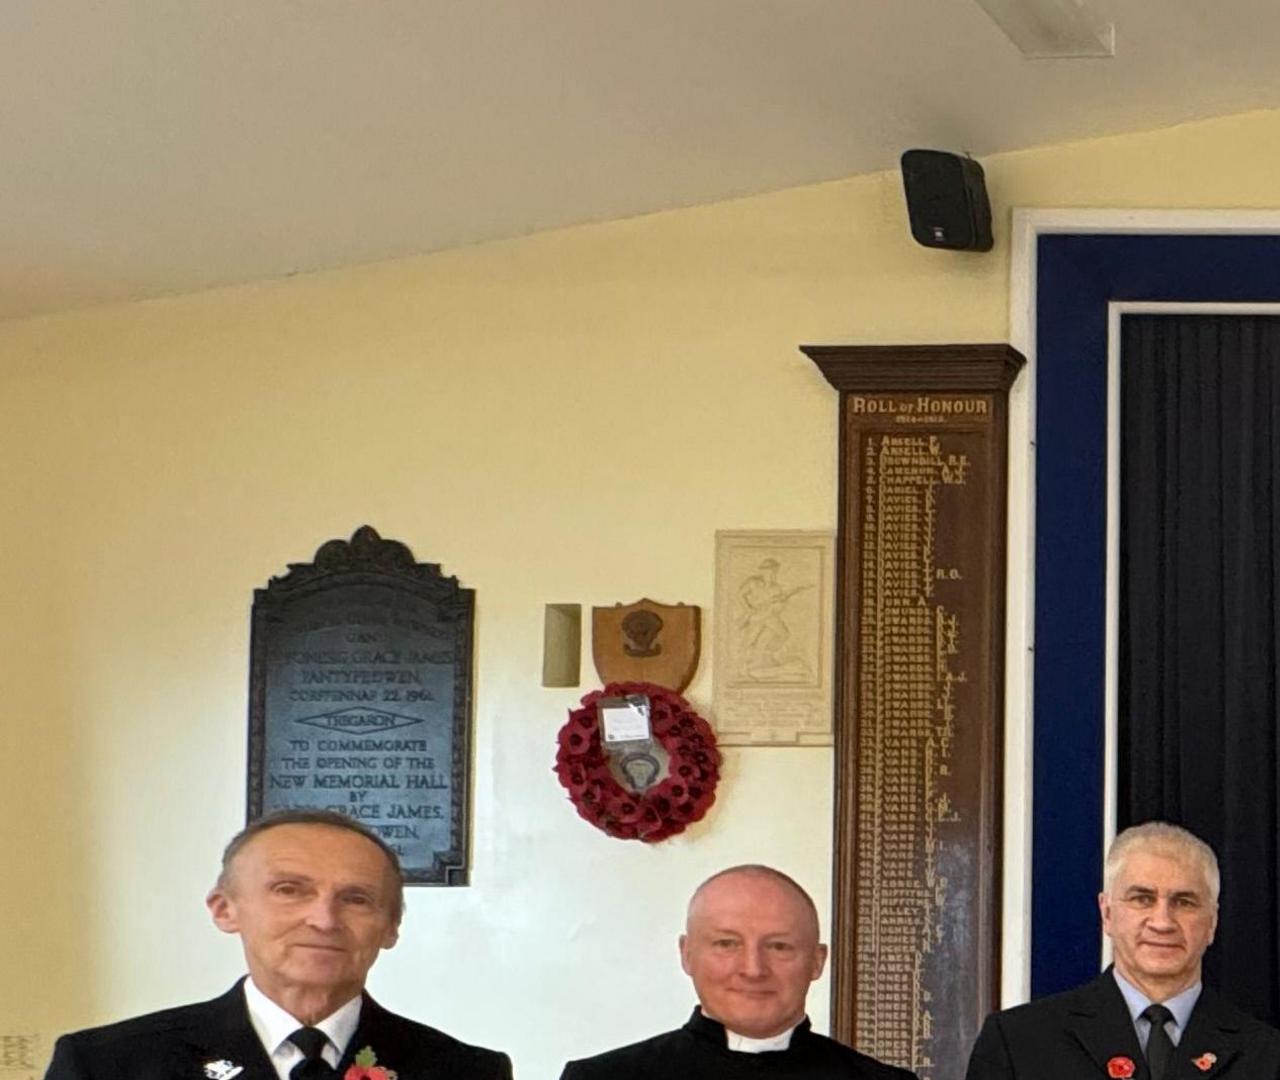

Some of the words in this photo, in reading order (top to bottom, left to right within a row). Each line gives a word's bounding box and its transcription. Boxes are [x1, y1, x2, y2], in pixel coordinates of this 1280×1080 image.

[853, 396, 896, 413] ROLL
[917, 396, 987, 413] HONOUR
[327, 715, 394, 727] TREGARON
[290, 740, 309, 751] TO
[317, 740, 426, 751] COMMEMORATE
[282, 757, 310, 769] THE
[316, 757, 377, 769] OPENING
[383, 757, 402, 769] OF
[407, 757, 435, 769] THE
[270, 775, 306, 788] NEW
[314, 774, 400, 788] MEMORIAL
[407, 775, 447, 788] HALL
[350, 791, 368, 802] BY
